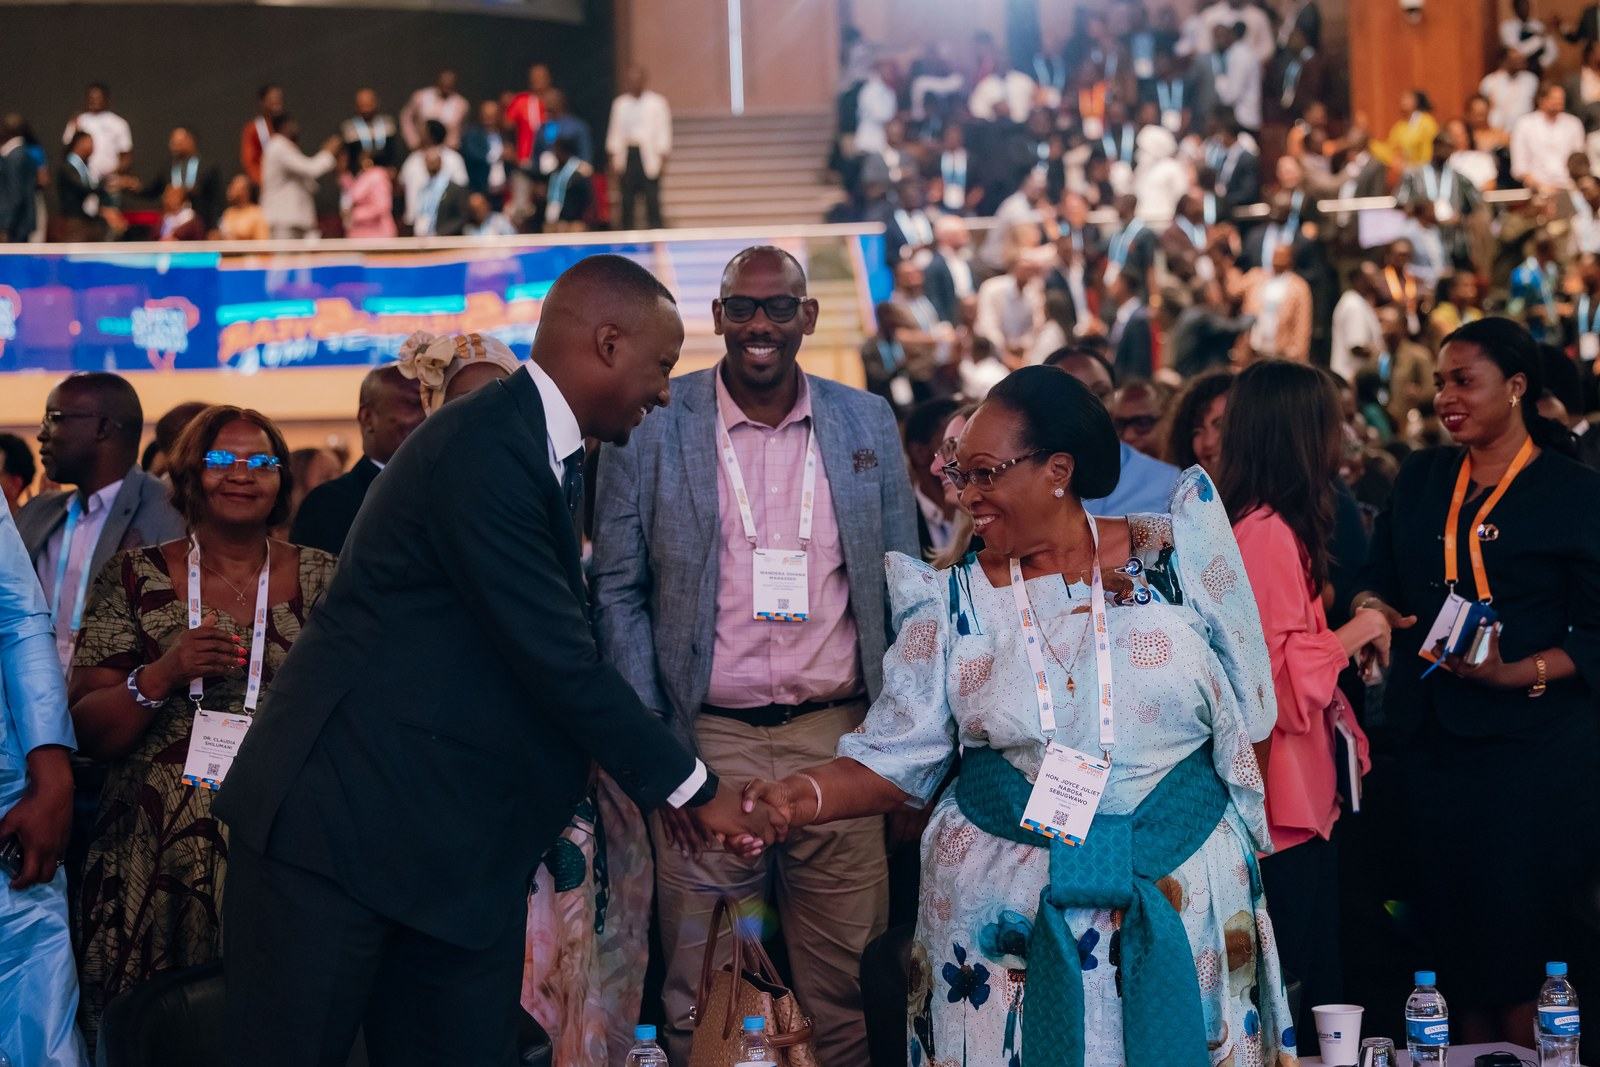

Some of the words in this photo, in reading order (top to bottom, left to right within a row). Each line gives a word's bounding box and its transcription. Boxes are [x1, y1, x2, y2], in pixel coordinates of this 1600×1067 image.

[213, 737, 236, 745] CLAUDIA
[1045, 773, 1060, 782] HON.
[1061, 779, 1080, 790] JOYCE
[1080, 786, 1101, 797] JULIET
[1058, 784, 1083, 797] NABOSA
[1049, 787, 1088, 806] SEBUGWAWO
